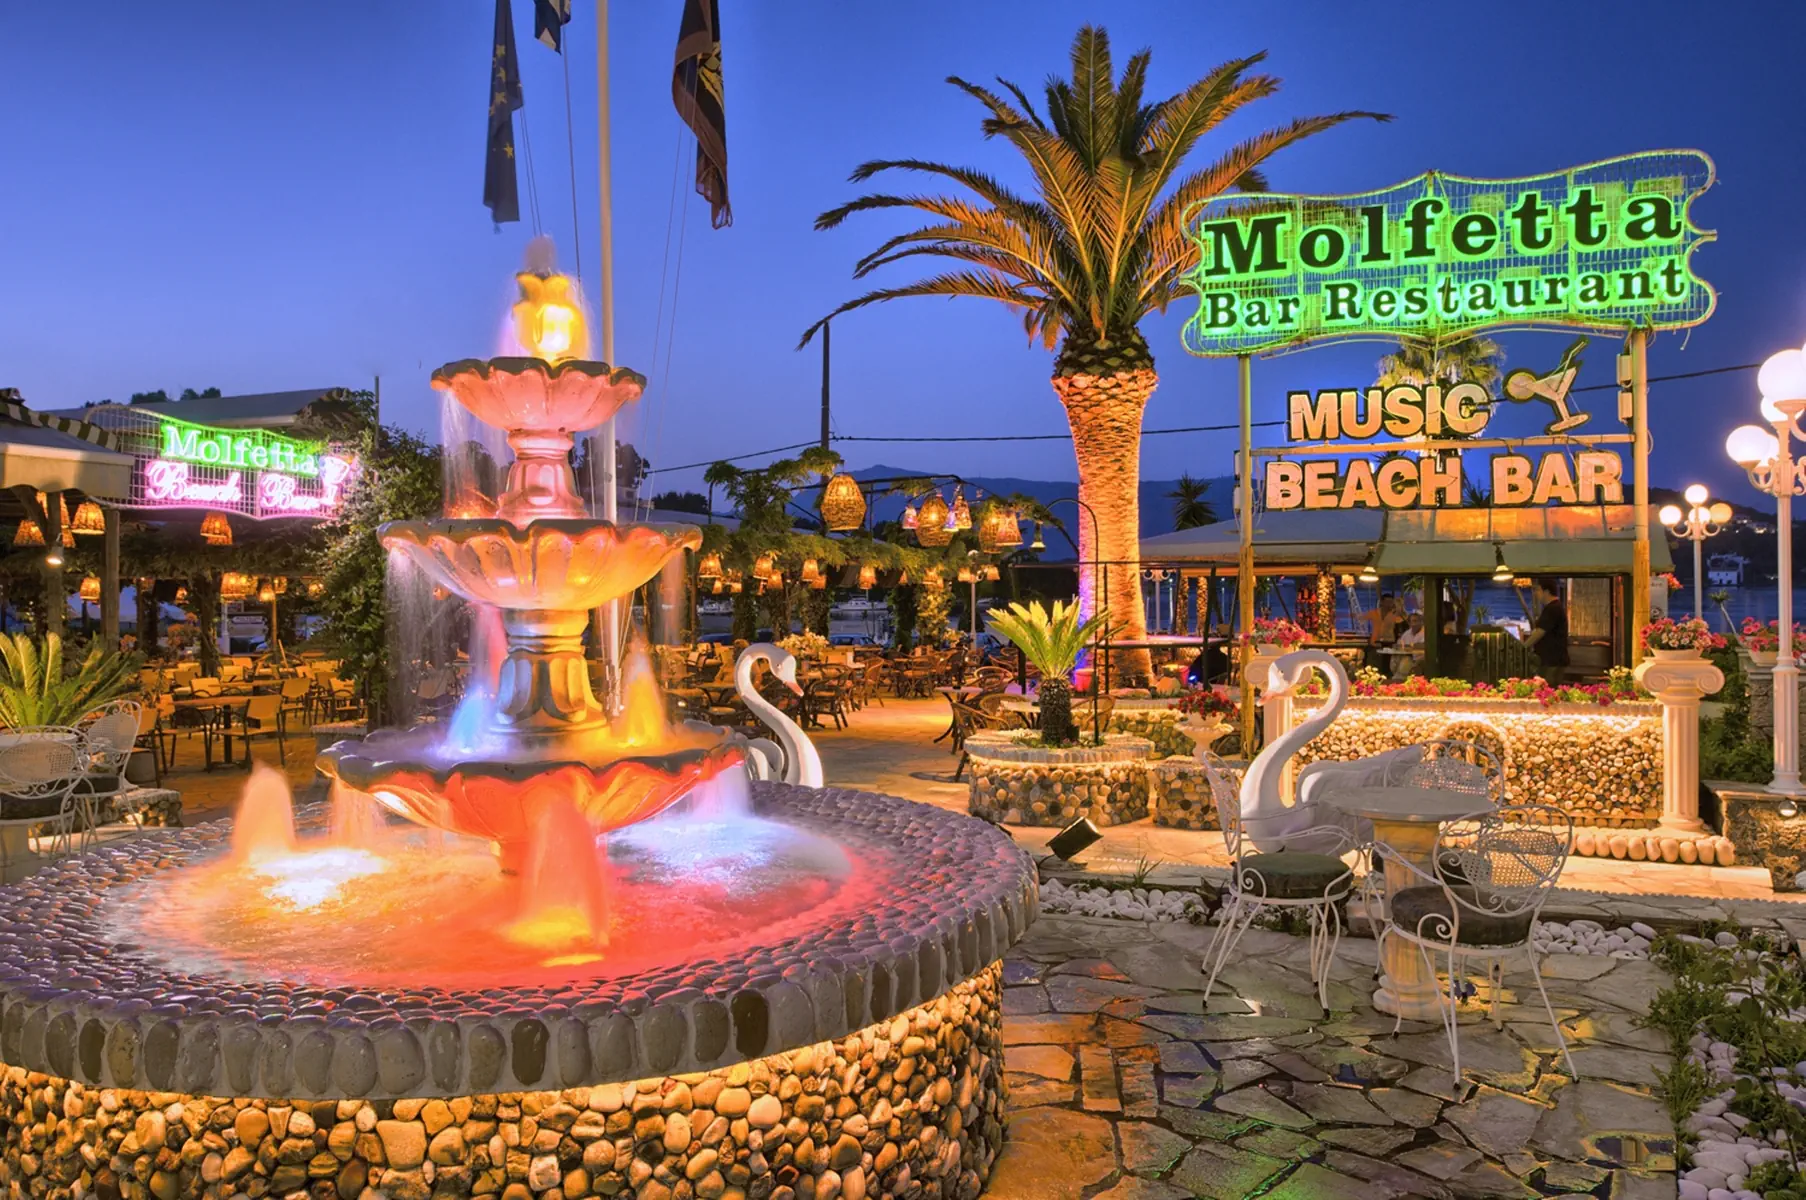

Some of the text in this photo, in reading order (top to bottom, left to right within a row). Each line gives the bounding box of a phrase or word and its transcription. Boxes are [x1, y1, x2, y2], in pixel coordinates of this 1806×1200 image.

[1202, 186, 1682, 277] Molfetta
[1205, 258, 1686, 330] Bar Restaurant
[1287, 382, 1490, 442] MUSIC
[164, 425, 318, 474] Molfetta
[1265, 451, 1624, 509] BEACH BAR
